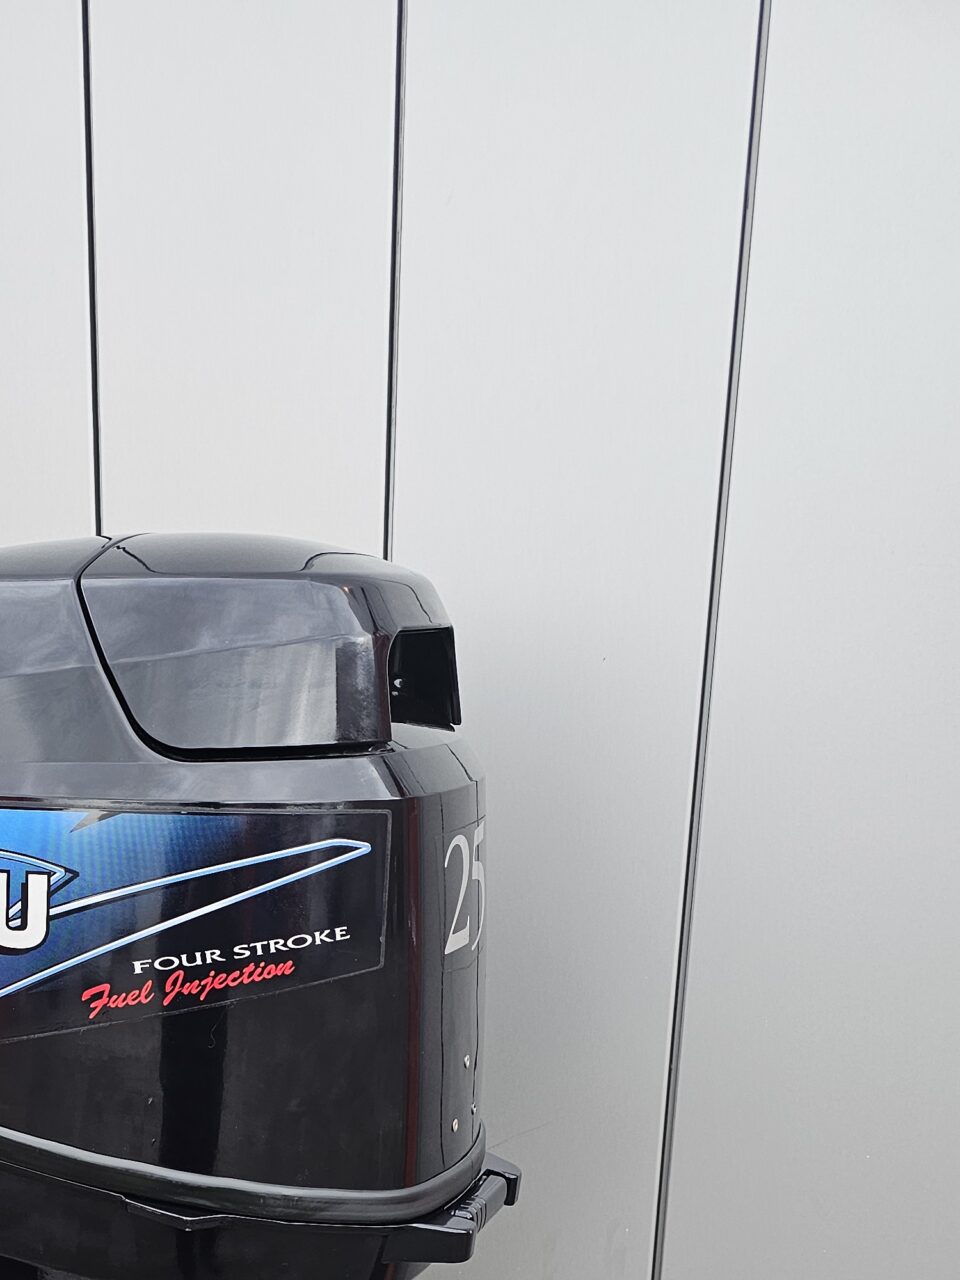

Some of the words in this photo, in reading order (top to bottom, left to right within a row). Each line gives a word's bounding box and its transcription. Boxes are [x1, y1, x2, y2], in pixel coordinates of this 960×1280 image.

[132, 949, 227, 975] FOUR
[233, 926, 351, 960] STROKE
[81, 979, 155, 1020] Fuel
[162, 959, 296, 1007] Injection
